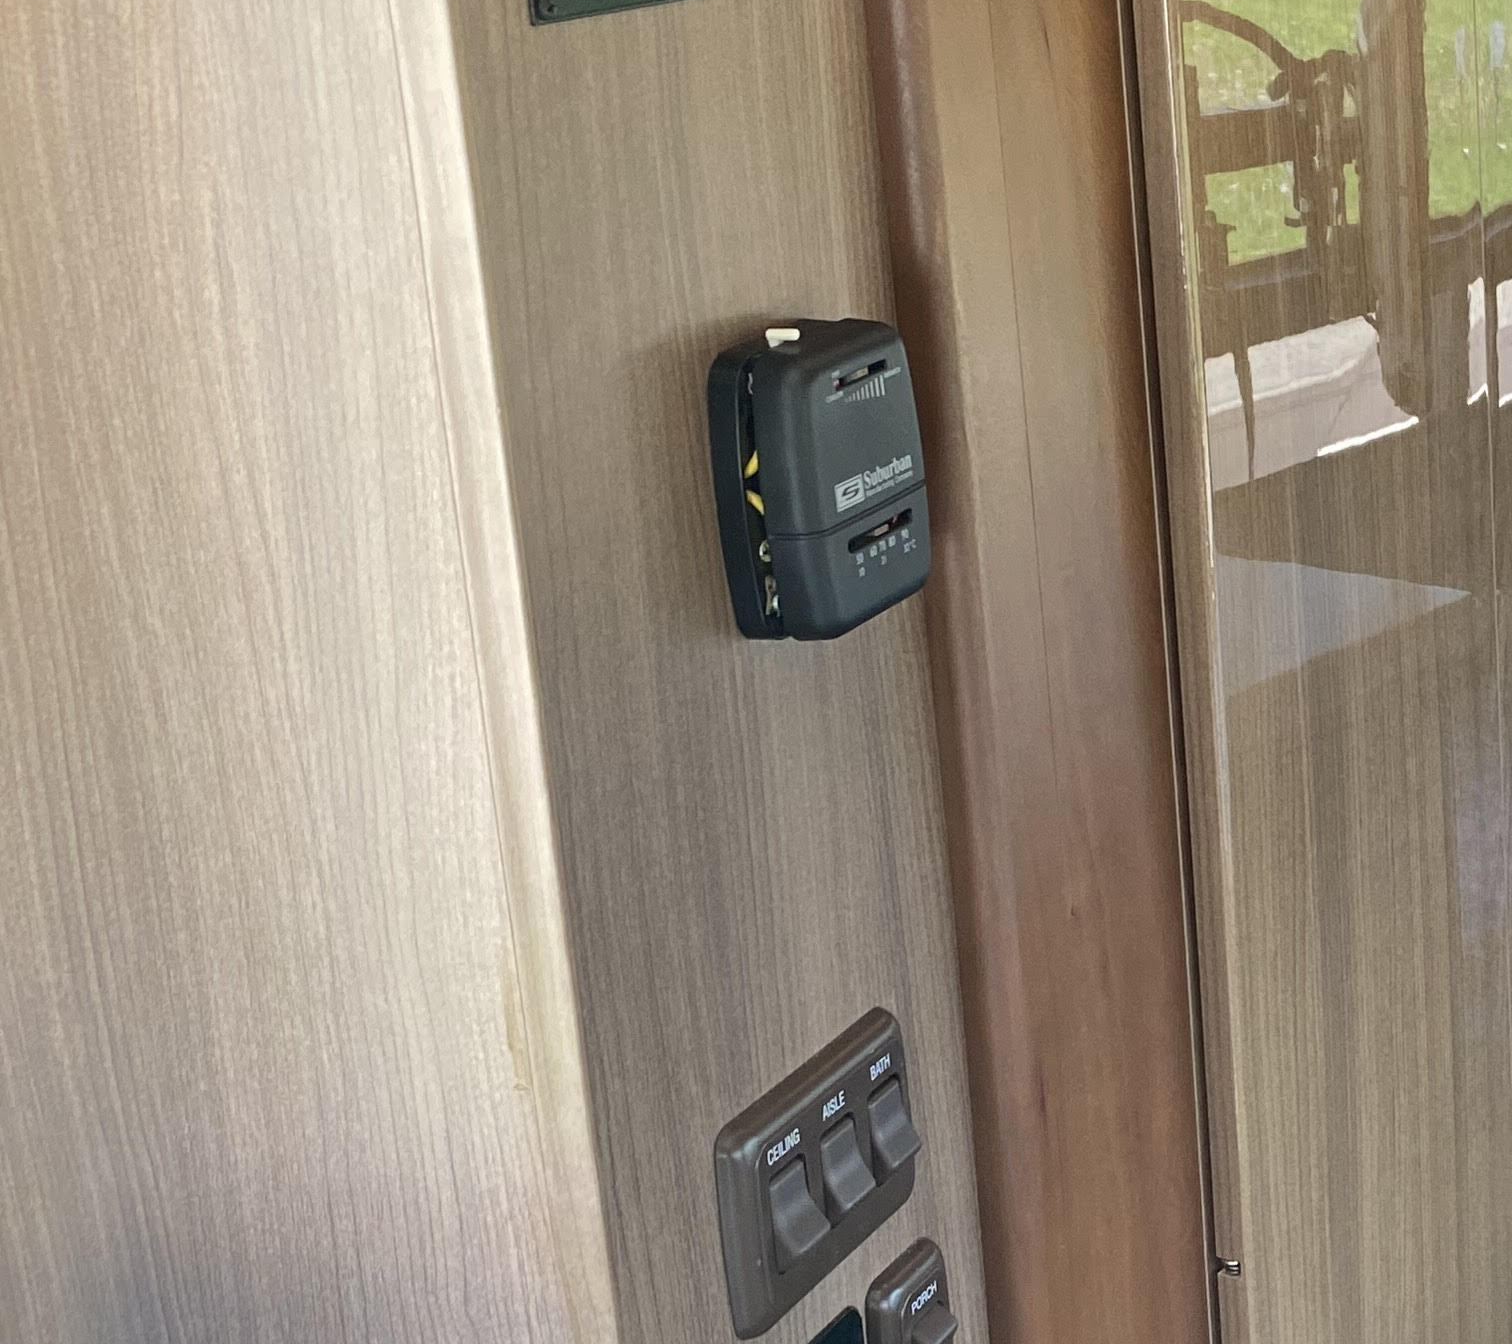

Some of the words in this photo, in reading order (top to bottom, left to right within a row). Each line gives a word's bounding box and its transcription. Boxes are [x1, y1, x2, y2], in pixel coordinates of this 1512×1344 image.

[863, 454, 913, 490] Suburban
[869, 1053, 891, 1081] BATH
[822, 1090, 845, 1122] AISLE
[766, 1128, 801, 1166] CEILING
[911, 1280, 938, 1316] PORCH
